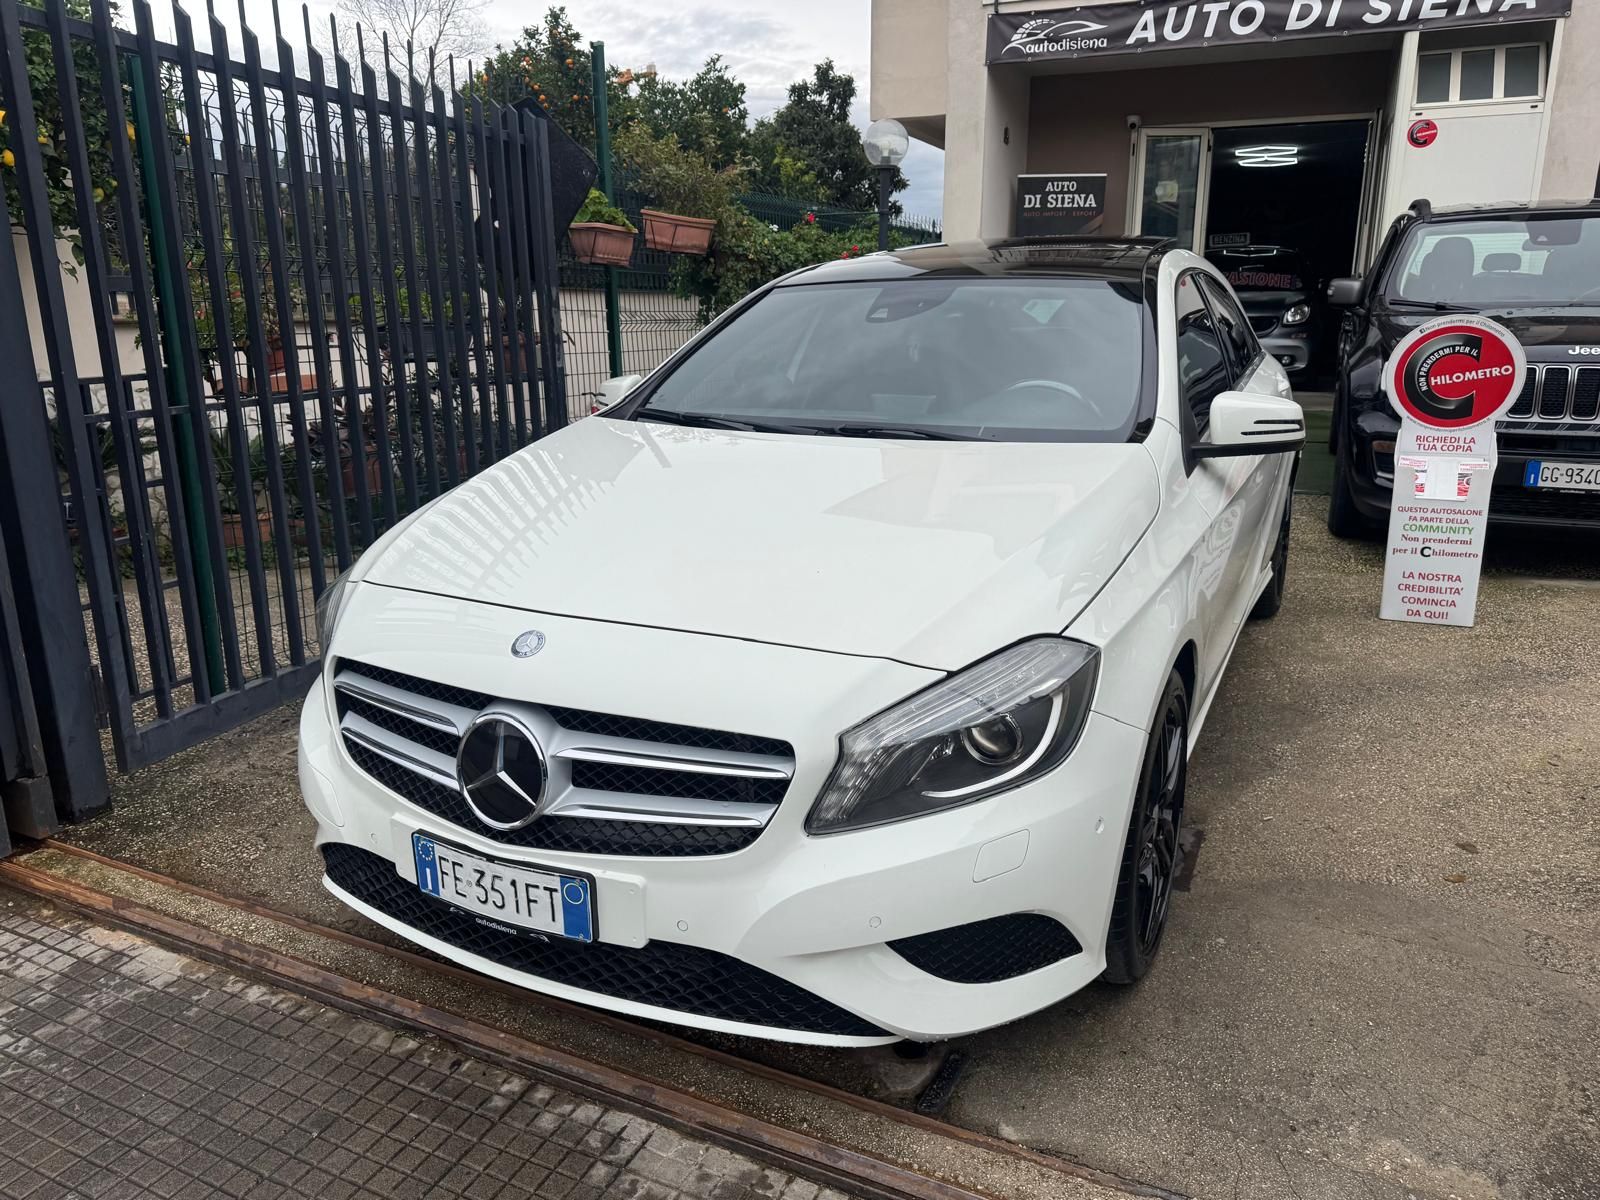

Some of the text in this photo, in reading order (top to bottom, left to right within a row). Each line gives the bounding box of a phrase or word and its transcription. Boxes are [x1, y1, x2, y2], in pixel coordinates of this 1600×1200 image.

[1125, 0, 1266, 45] AUTO
[1285, 0, 1342, 31] DI
[1025, 37, 1107, 54] autodisiena
[1045, 181, 1077, 192] AUTO
[1024, 193, 1097, 208] DI SIENA
[1226, 272, 1291, 289] ASIONE
[1419, 346, 1478, 392] NON PRENDERMI PER IL
[1415, 435, 1476, 445] RICHIEDI LA
[1416, 443, 1473, 453] TUA COPIA
[1397, 506, 1483, 516] QUESTO AUTOSALONE
[1445, 517, 1469, 525] DELLA
[1402, 523, 1474, 535] COMMUNITY
[1401, 534, 1472, 545] Non prendermi
[1392, 546, 1479, 559] per il Chilometro
[1402, 571, 1462, 583] LA NOSTRA
[1397, 583, 1464, 595] CREDIBILITA'
[1401, 596, 1457, 608] COMINCIA
[1406, 609, 1449, 619] DA QUI!
[475, 916, 517, 935] autodisiena
